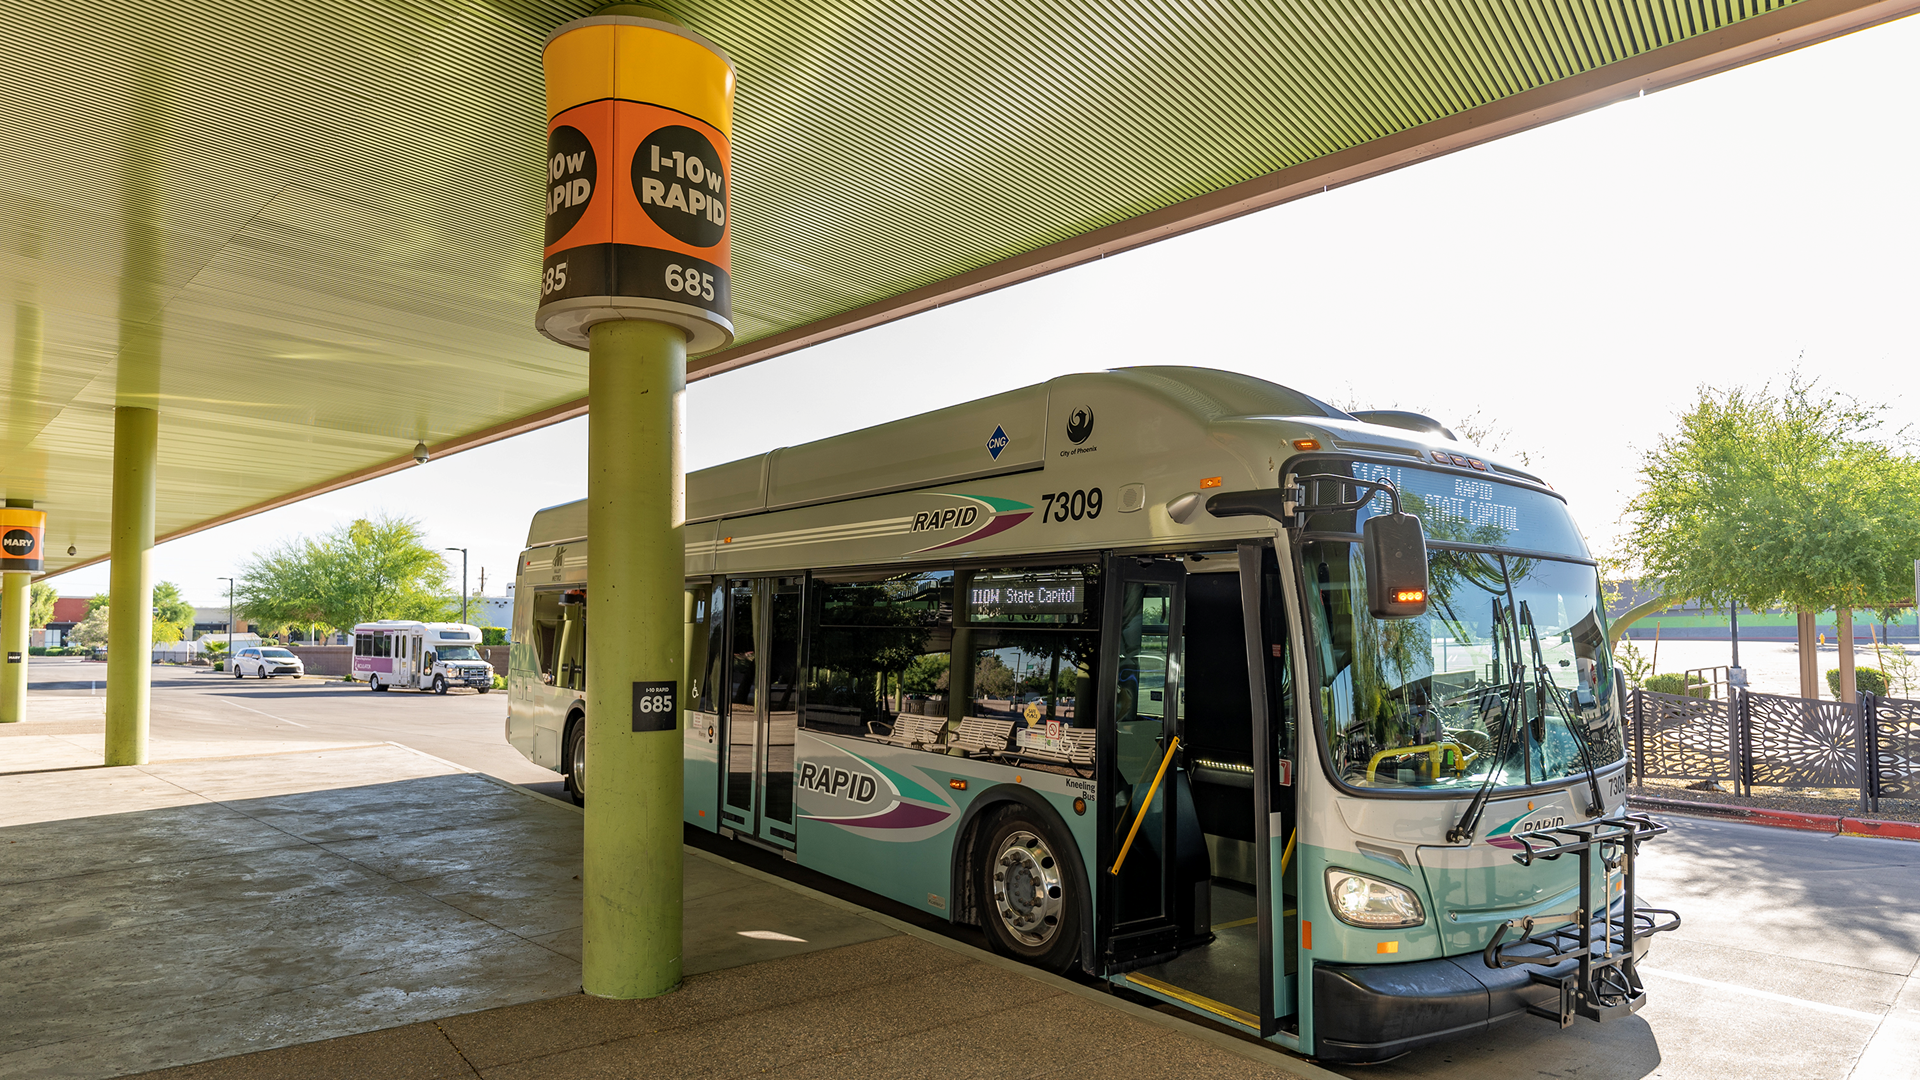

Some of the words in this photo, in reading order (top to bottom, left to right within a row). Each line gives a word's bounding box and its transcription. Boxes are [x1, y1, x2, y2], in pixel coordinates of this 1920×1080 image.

[545, 178, 592, 219] APID
[641, 176, 726, 228] RAPID
[664, 263, 716, 302] 685
[988, 436, 1007, 449] CNG
[1060, 449, 1070, 458] City
[1071, 447, 1077, 455] of
[1077, 445, 1098, 455] Phoenix
[1454, 478, 1493, 501] RAPID
[1041, 487, 1103, 523] 7309
[1424, 493, 1466, 525] STATE
[1469, 500, 1520, 532] CAPITOL
[912, 506, 979, 534] RAPID
[3, 538, 34, 547] MARY
[1006, 588, 1035, 604] State
[1038, 586, 1075, 603] Capitol
[640, 695, 673, 714] 685
[799, 763, 877, 804] RAPID
[1065, 777, 1097, 794] Kneeling
[1608, 773, 1626, 797] 7309
[1082, 791, 1097, 802] Bus
